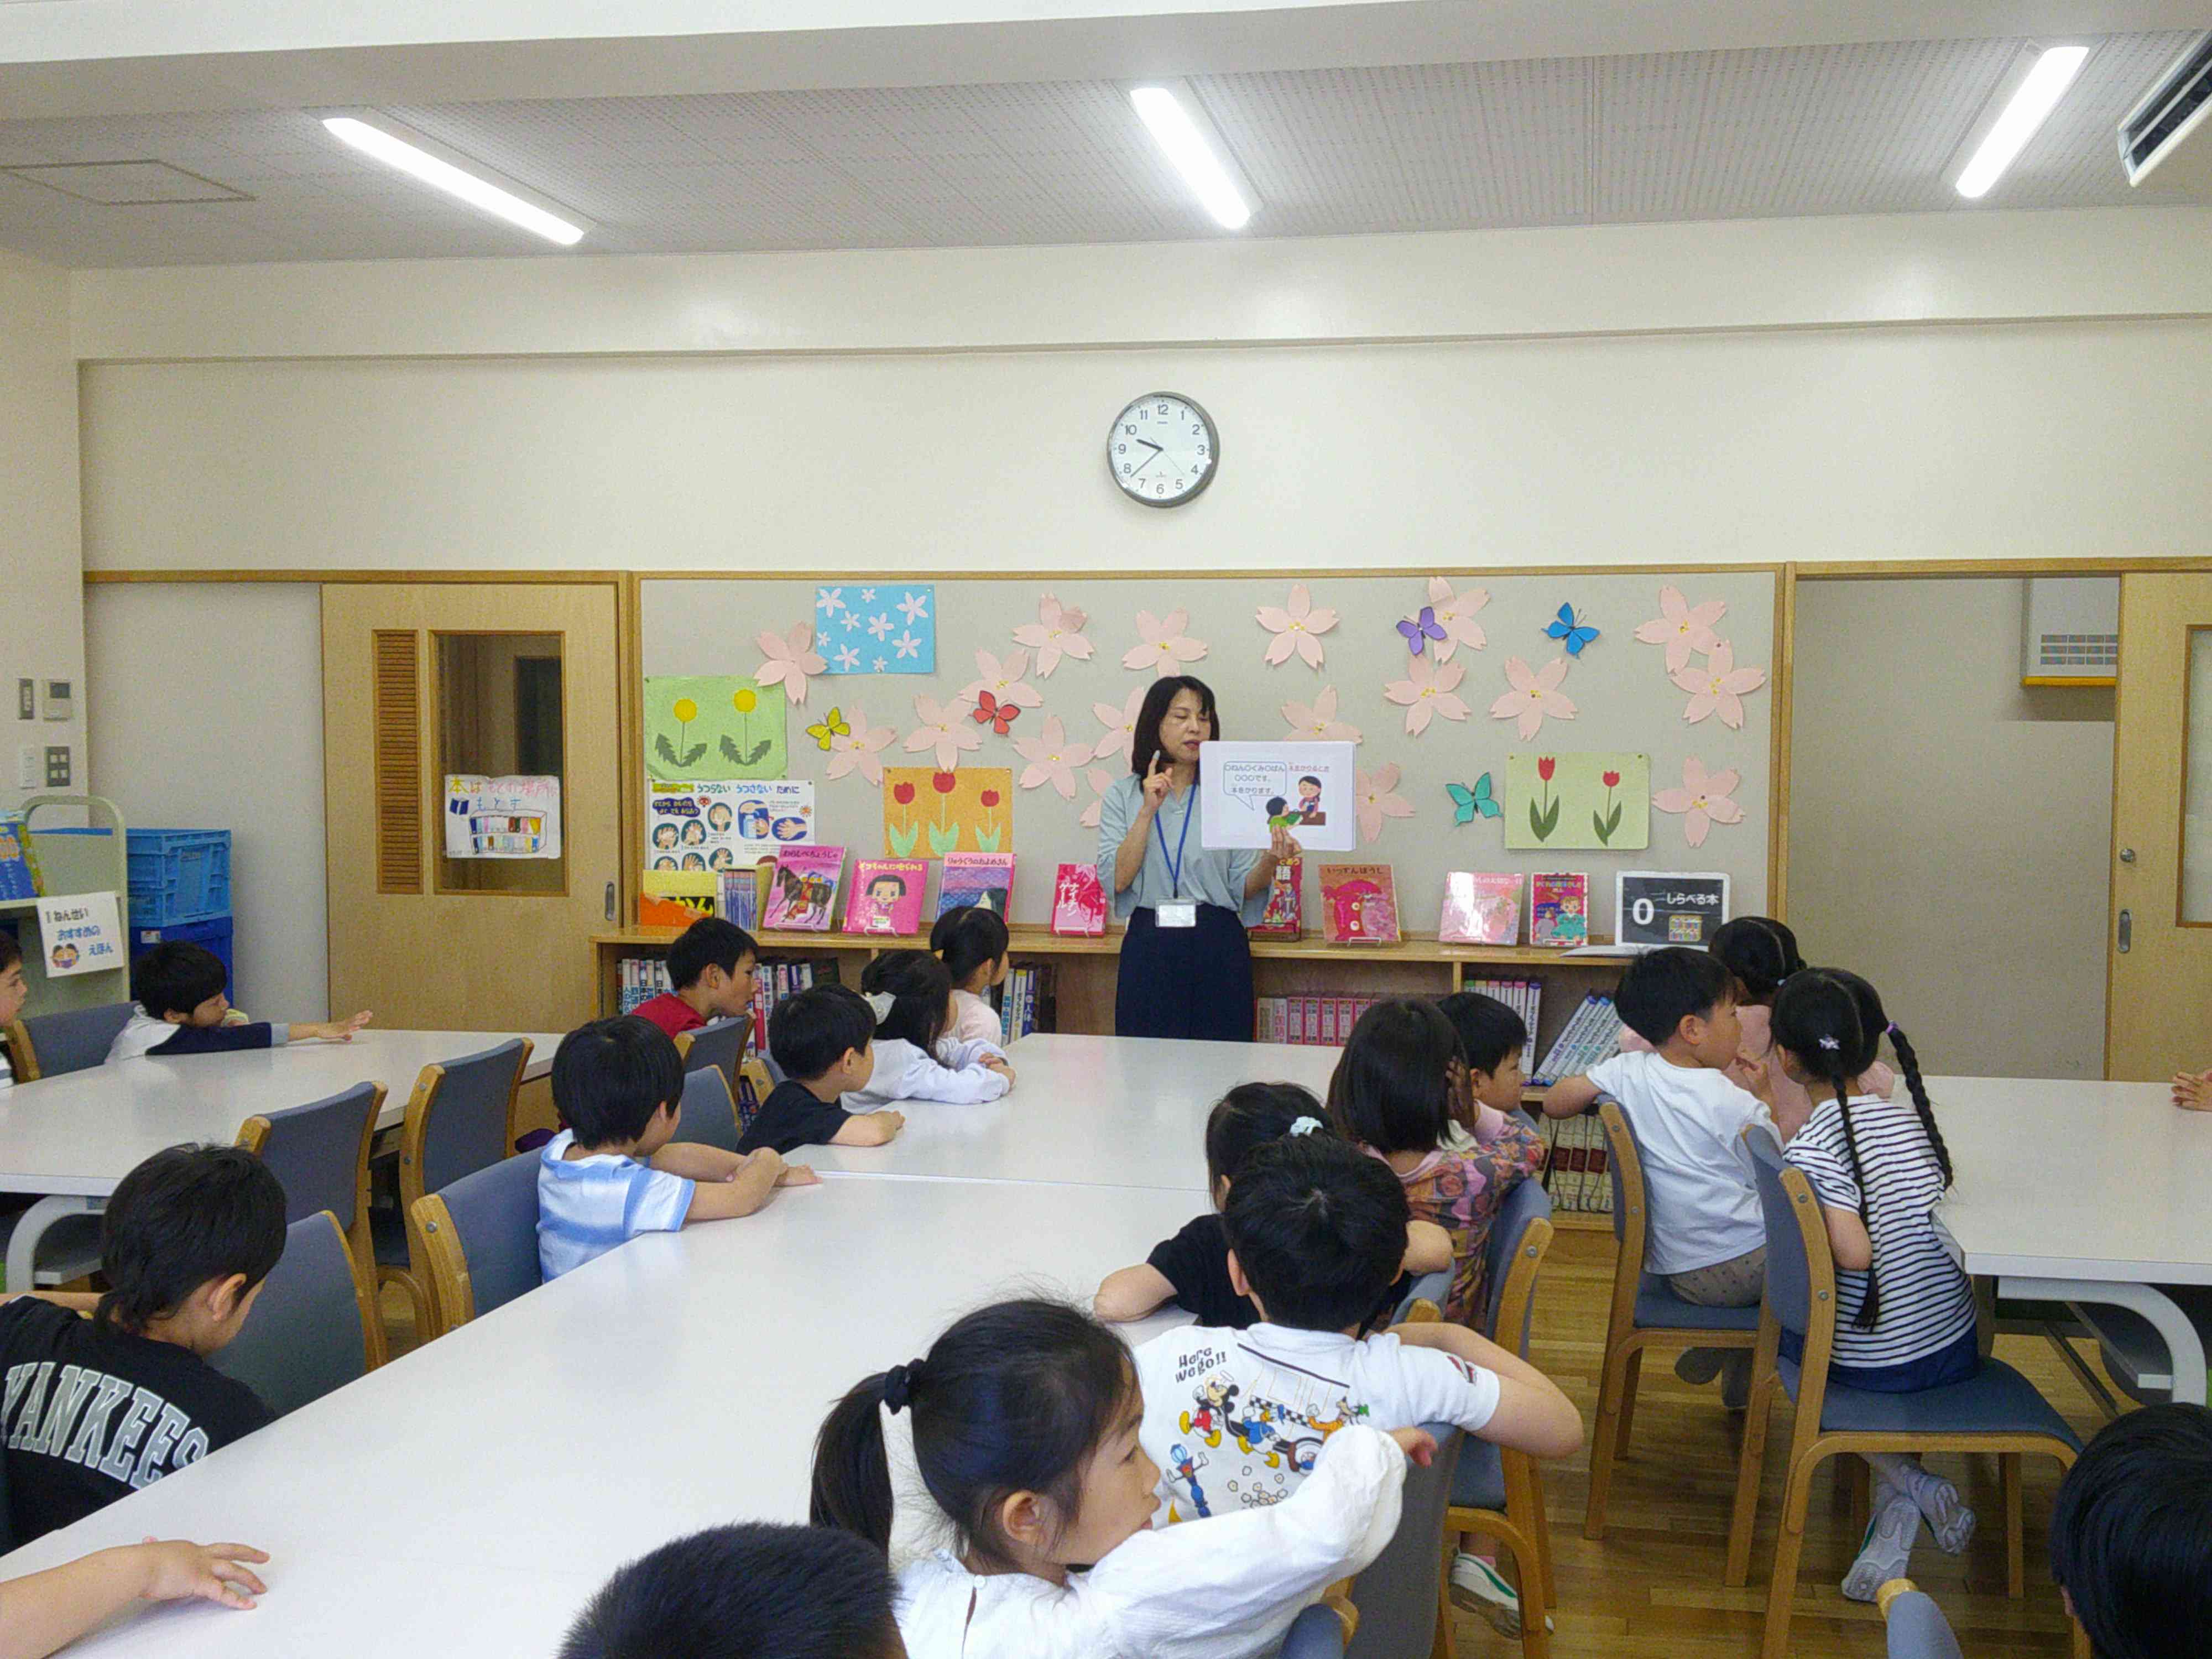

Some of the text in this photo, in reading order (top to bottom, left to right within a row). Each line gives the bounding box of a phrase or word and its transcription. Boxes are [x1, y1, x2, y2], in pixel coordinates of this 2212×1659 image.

[1157, 404, 1168, 415] 12
[1140, 410, 1148, 420] 11
[1181, 410, 1185, 420] 1
[1125, 425, 1137, 435] 10
[1192, 425, 1200, 435] 2
[1118, 444, 1126, 454] 9
[1197, 445, 1205, 455] 3
[1124, 463, 1131, 473] 8
[1191, 465, 1198, 474] 4
[1139, 478, 1146, 488] 7
[1175, 479, 1183, 489] 5
[1156, 484, 1164, 494] 6
[776, 785, 800, 794] ために
[1666, 893, 1719, 906] しらべる本
[1632, 898, 1655, 925] 0
[57, 925, 101, 941] おすすめの
[88, 942, 114, 957] えほん
[1179, 1347, 1212, 1368] Here
